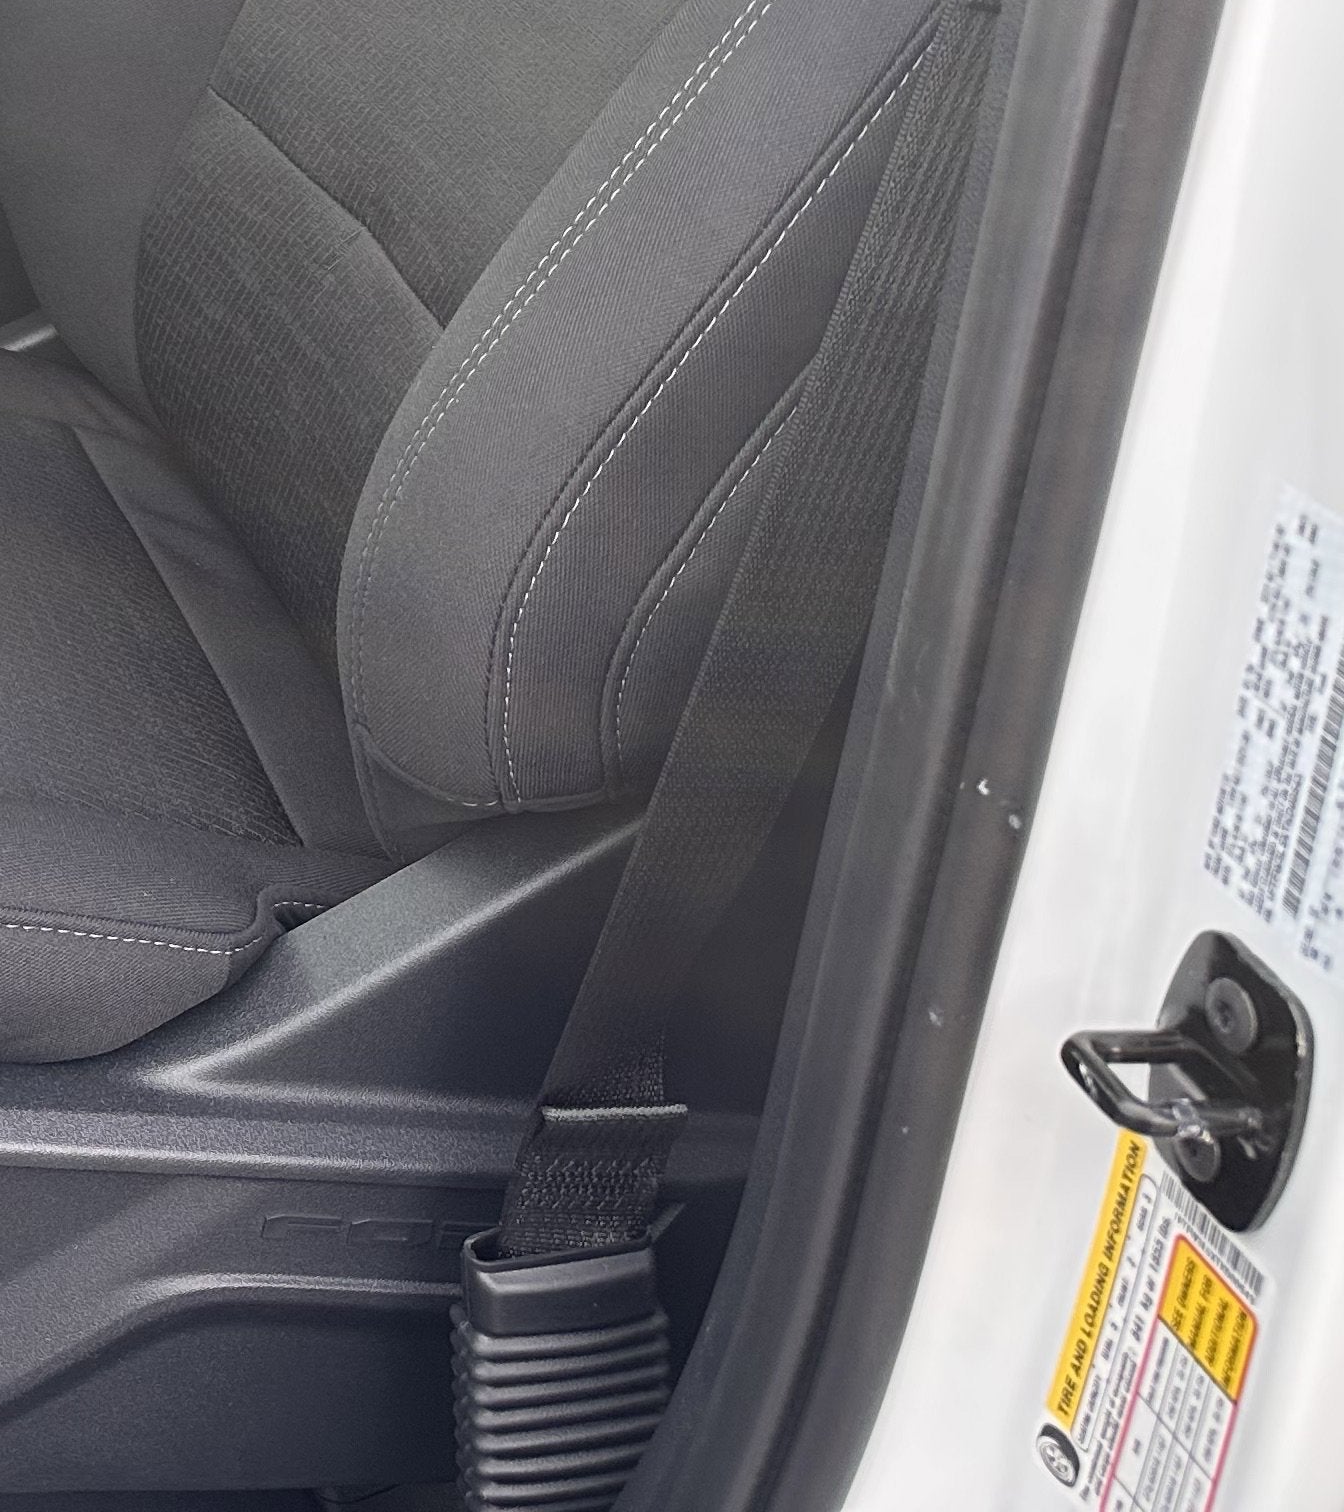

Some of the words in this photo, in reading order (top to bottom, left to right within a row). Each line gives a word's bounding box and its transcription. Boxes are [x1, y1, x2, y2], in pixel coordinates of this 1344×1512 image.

[1101, 1139, 1141, 1260] INFORMATION
[1079, 1259, 1110, 1334] LOADING
[1071, 1337, 1090, 1375] AND
[1057, 1373, 1077, 1417] TIRE
